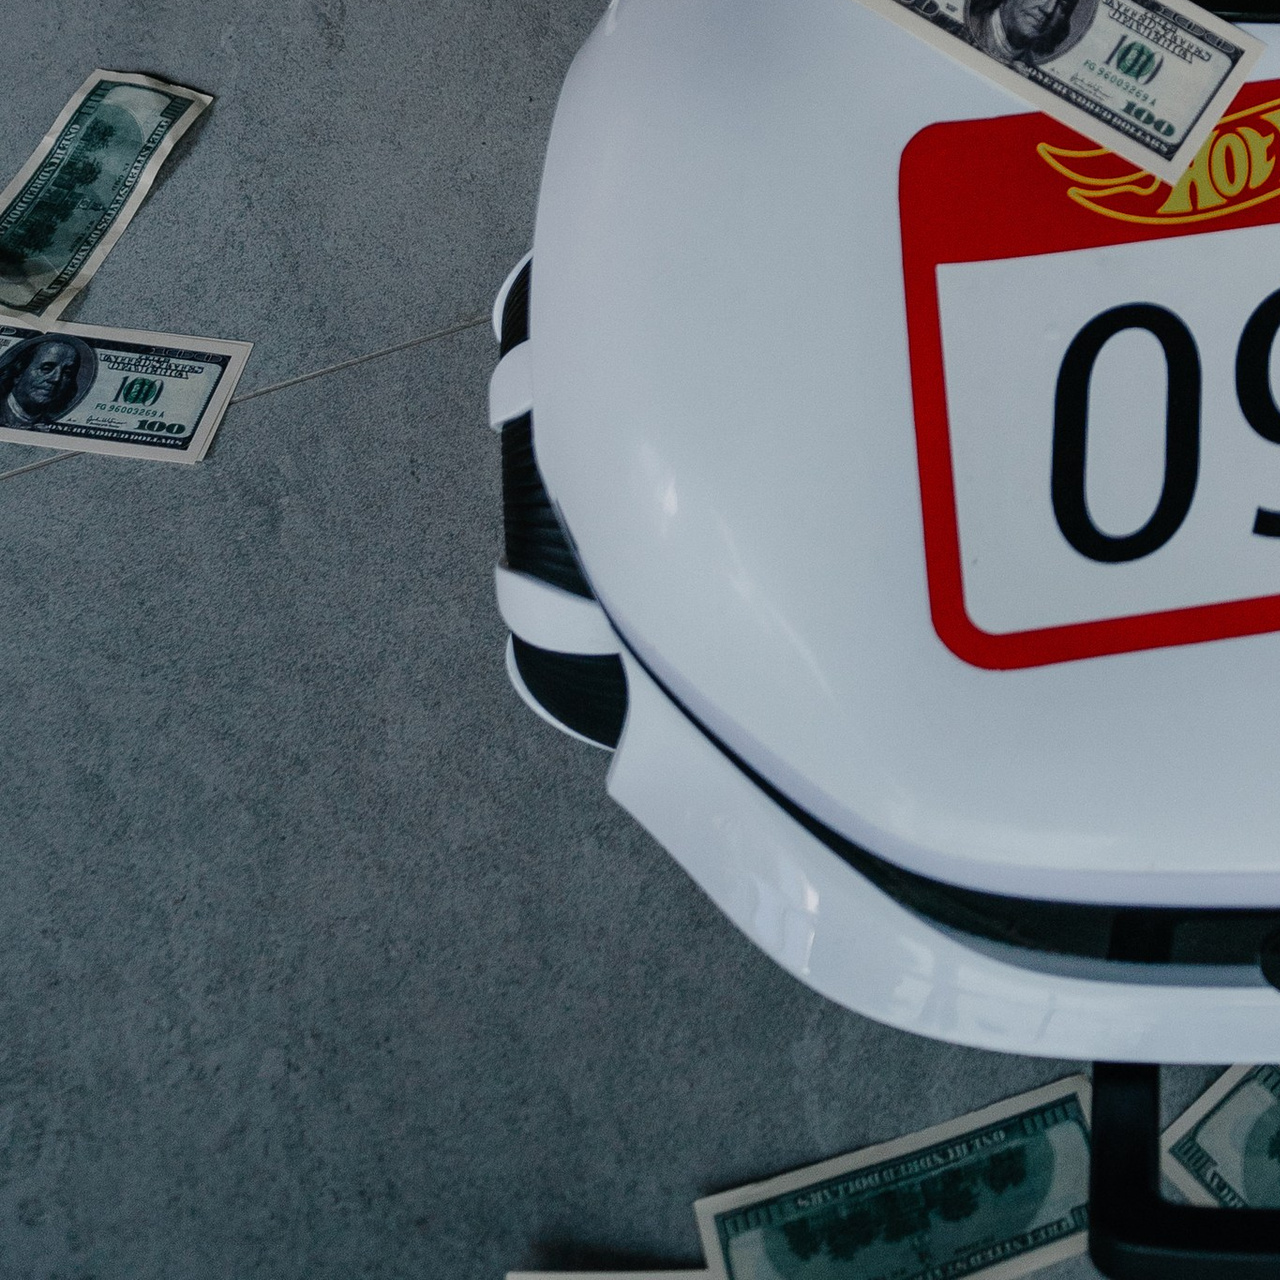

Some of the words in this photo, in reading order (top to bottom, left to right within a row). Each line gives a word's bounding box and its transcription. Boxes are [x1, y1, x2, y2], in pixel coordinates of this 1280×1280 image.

[1081, 58, 1097, 72] FG
[1095, 66, 1150, 103] 96003269
[1148, 96, 1158, 107] A
[57, 121, 81, 150] ONE
[1120, 98, 1178, 139] 100
[21, 146, 66, 204] HUNDRED
[122, 141, 154, 187] UNITED
[94, 184, 130, 231] STATES
[94, 402, 106, 410] FG
[107, 404, 157, 417] 96003269
[134, 418, 186, 436] 100
[47, 422, 72, 432] ONE
[71, 425, 129, 439] HUNDRED
[129, 432, 183, 446] DOLLARS
